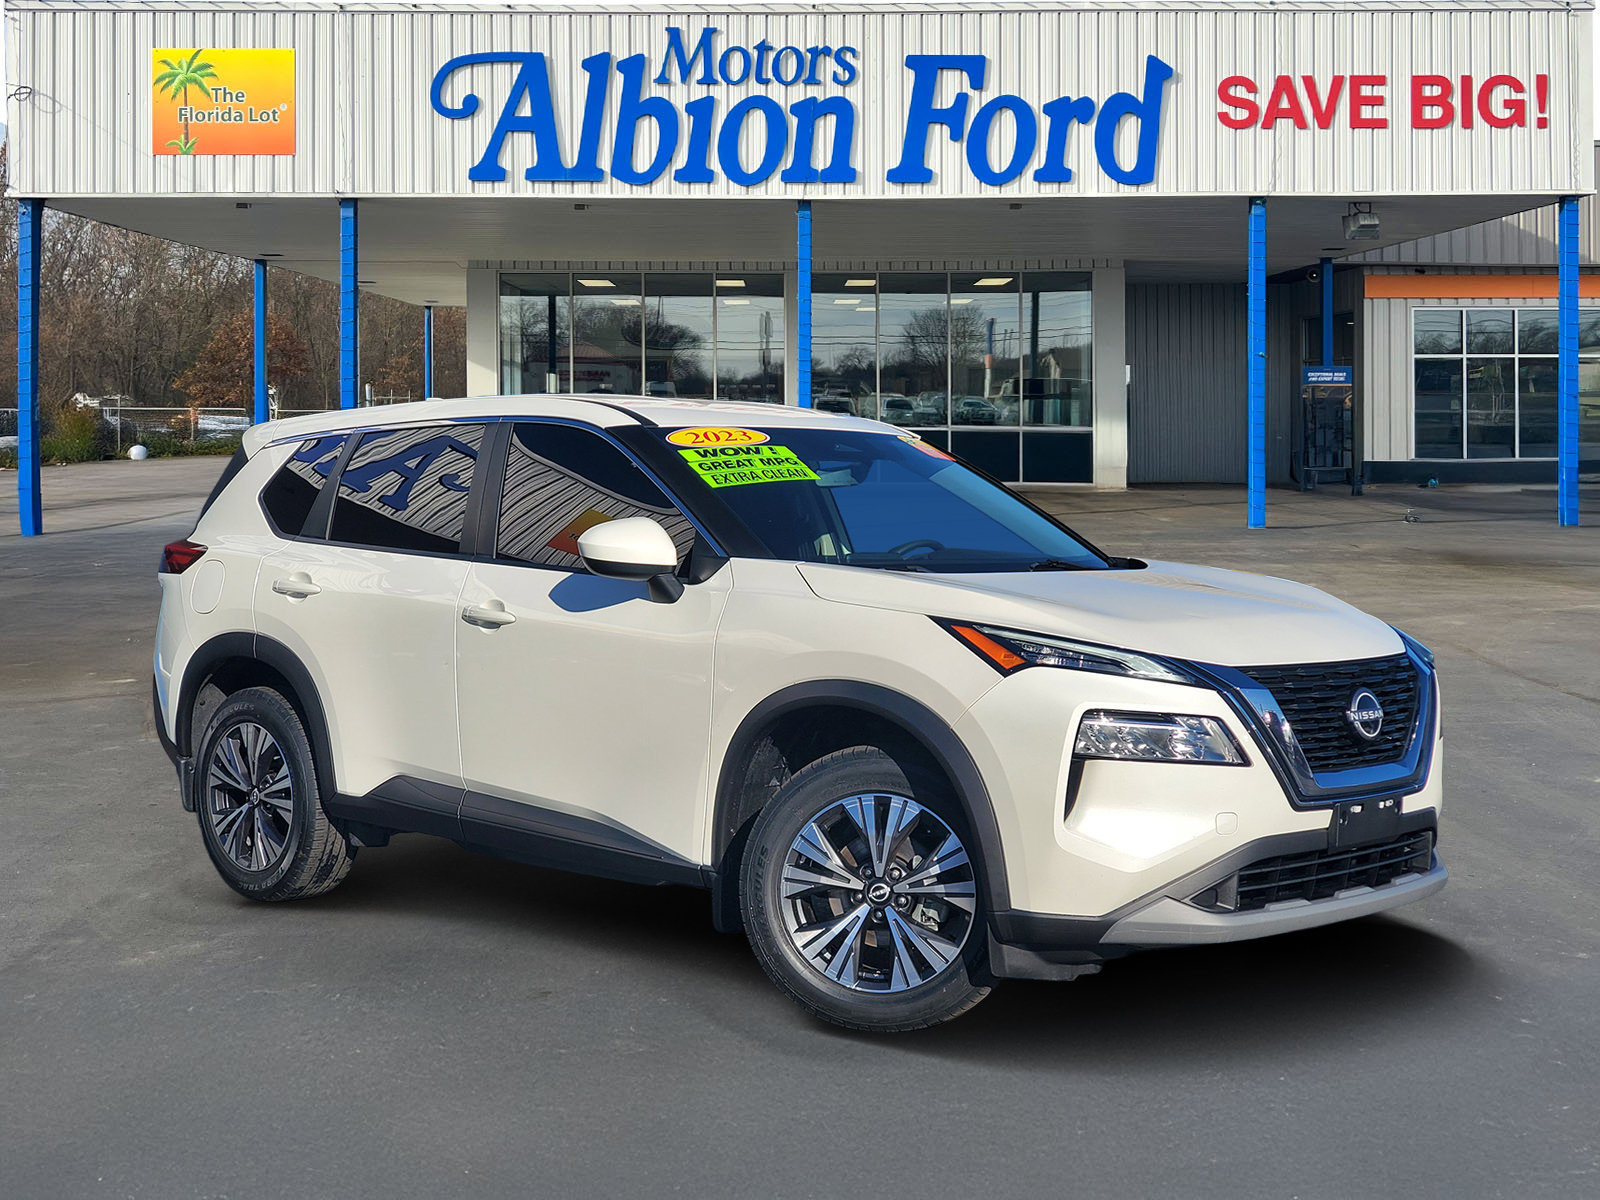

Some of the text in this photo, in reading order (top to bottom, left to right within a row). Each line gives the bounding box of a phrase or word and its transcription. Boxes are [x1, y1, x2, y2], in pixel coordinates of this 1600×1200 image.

[653, 27, 857, 86] Motors
[211, 86, 245, 103] The
[1217, 74, 1548, 130] SAVE BIG!
[178, 107, 279, 123] Florida Lot
[430, 51, 1175, 188] Albion Ford
[685, 430, 753, 444] 2023
[694, 446, 764, 459] WOW
[697, 457, 799, 471] GREAT MPG
[711, 468, 808, 485] EXTRA CLEAN
[1350, 710, 1384, 721] NISSAN
